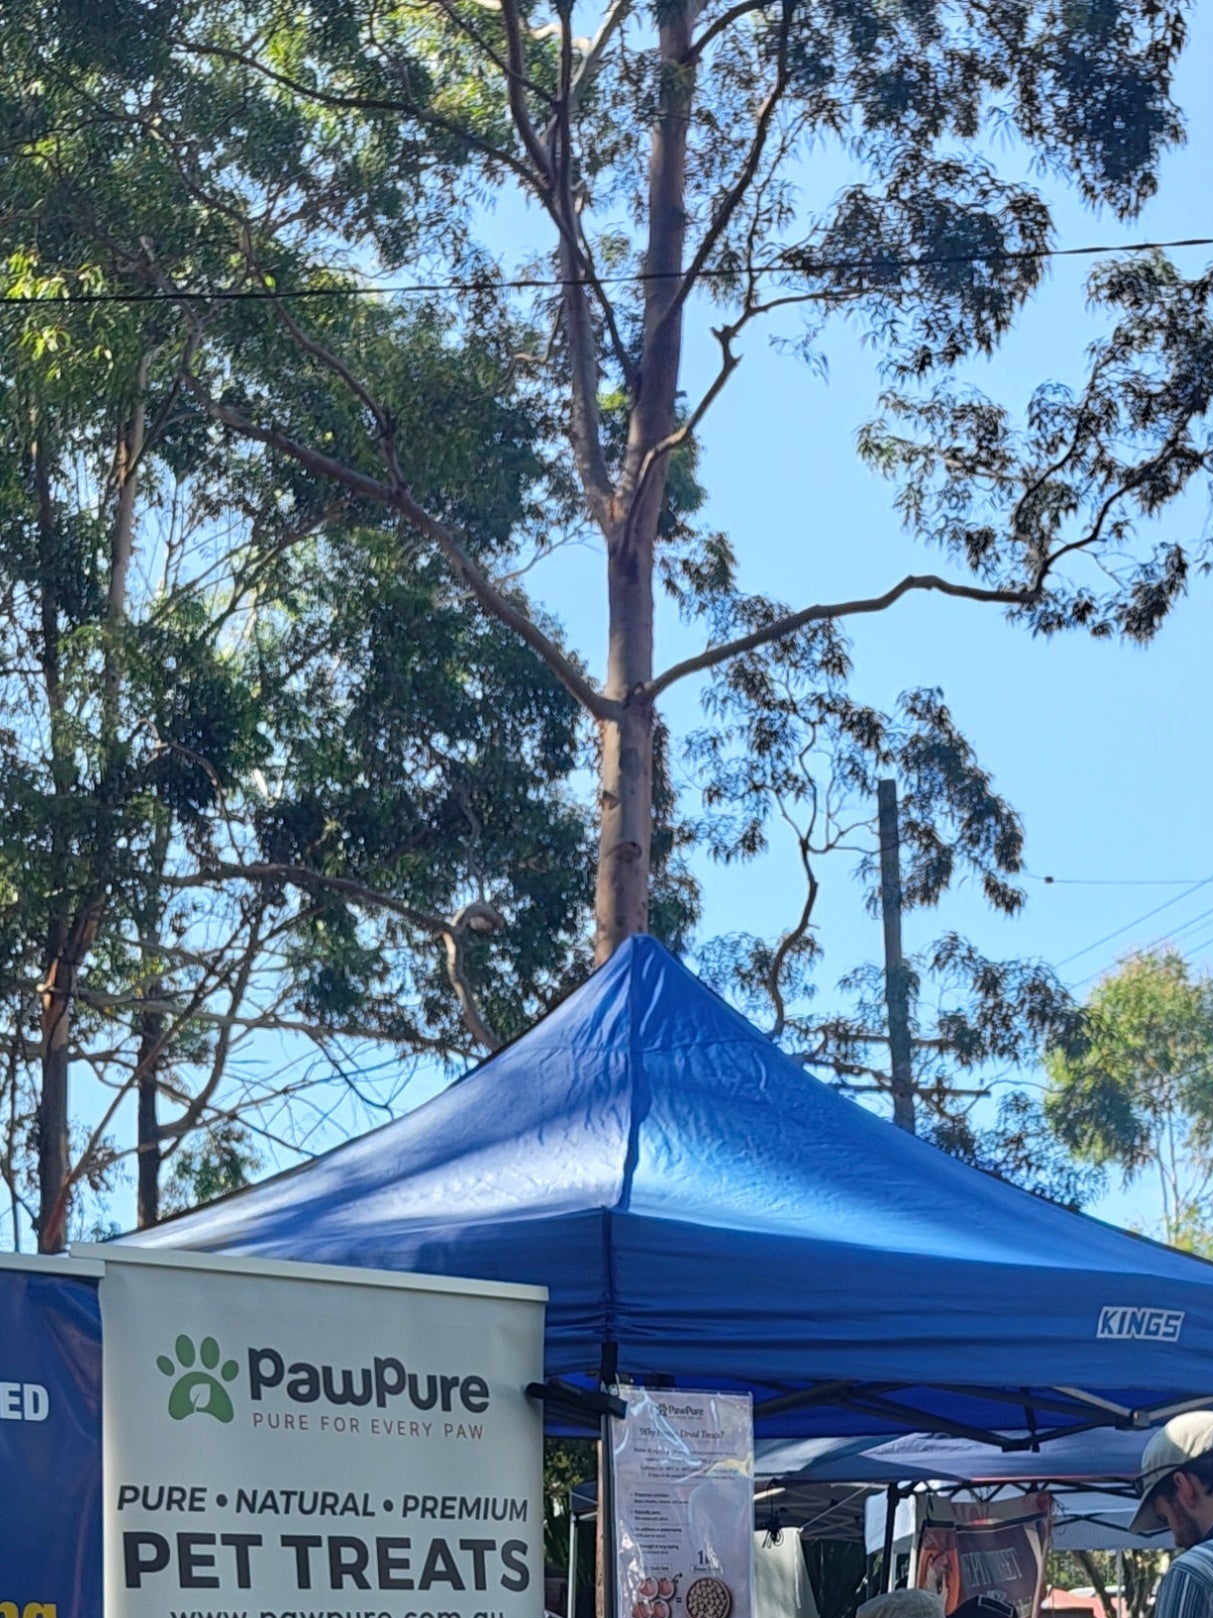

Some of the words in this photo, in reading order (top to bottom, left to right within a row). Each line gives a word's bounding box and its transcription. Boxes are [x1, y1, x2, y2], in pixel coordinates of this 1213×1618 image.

[1097, 1306, 1185, 1342] KINGS
[248, 1347, 490, 1413] PawPure
[0, 1382, 49, 1421] ED
[252, 1412, 309, 1431] PURE
[320, 1415, 361, 1434] FOR
[371, 1419, 433, 1438] EVERY
[443, 1422, 484, 1440] PAW
[116, 1485, 207, 1512] PURE
[235, 1488, 375, 1517] NATURAL
[401, 1494, 529, 1523] PREMIUM
[122, 1531, 263, 1589] PET
[280, 1534, 530, 1593] TREATS
